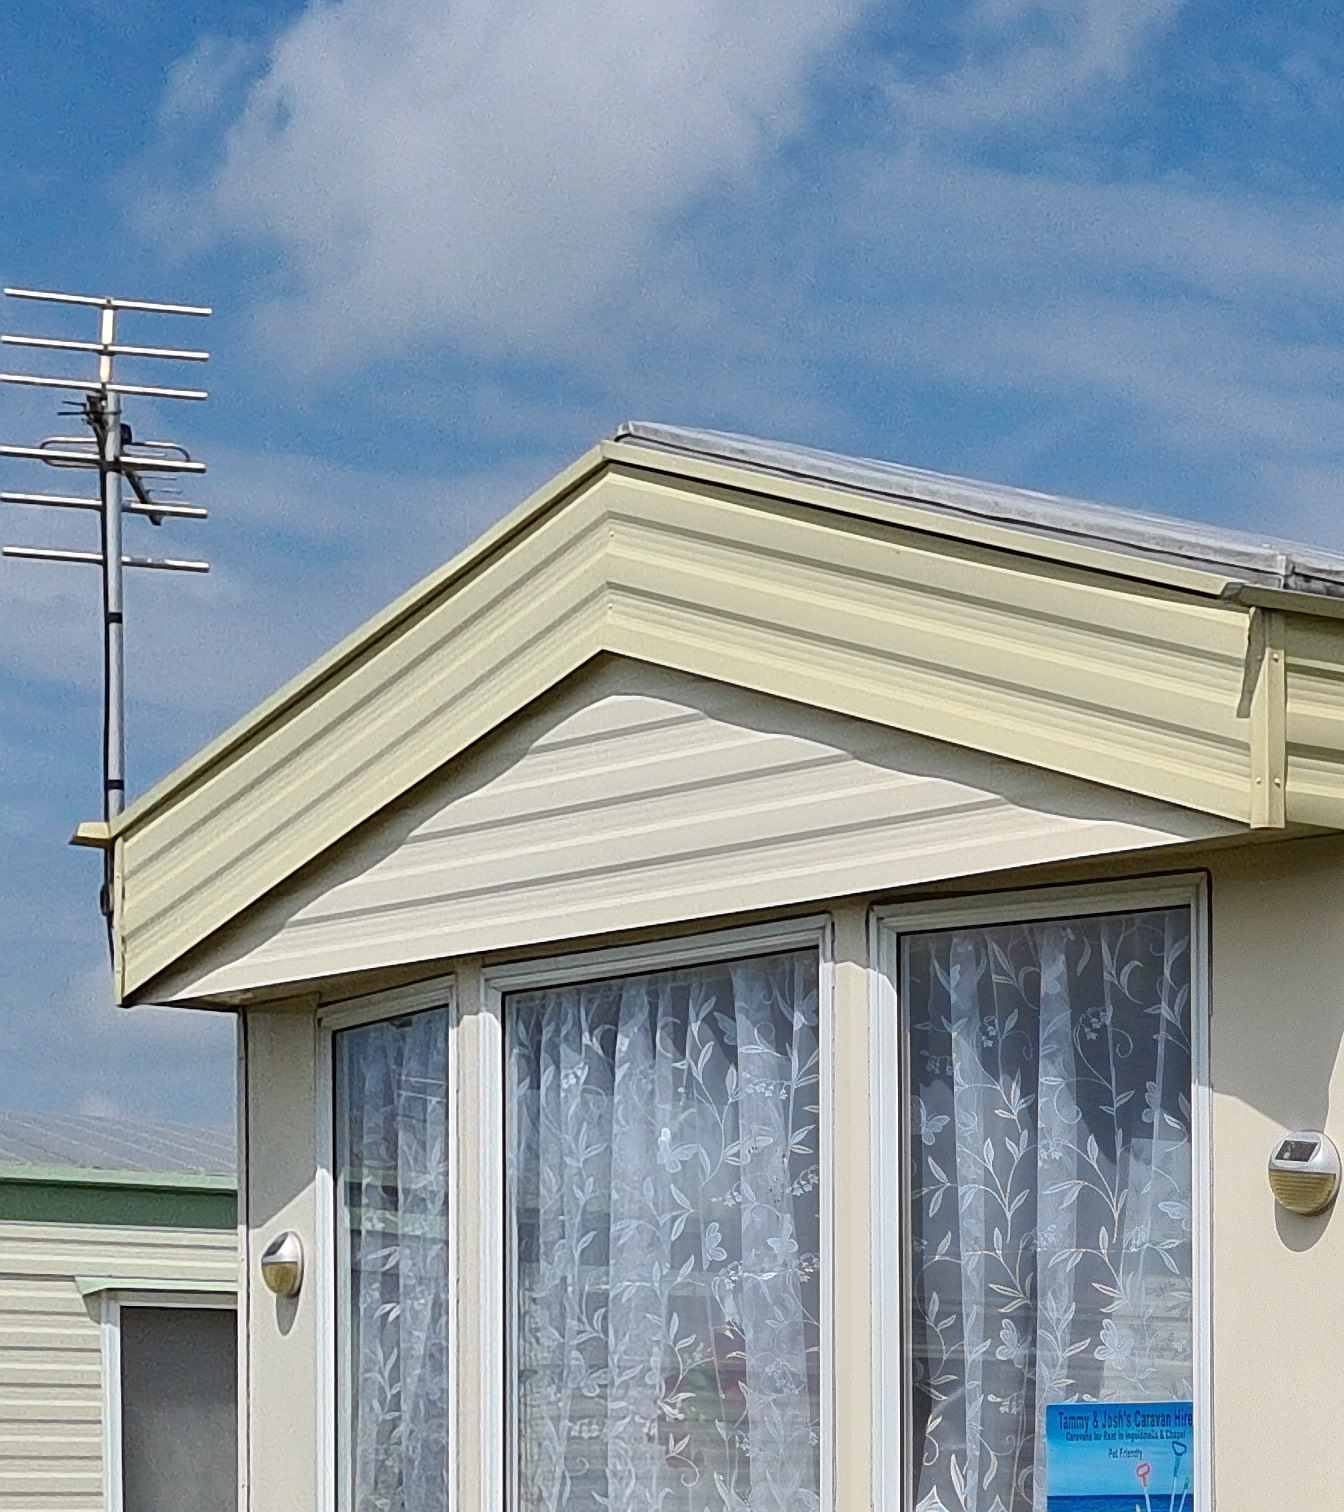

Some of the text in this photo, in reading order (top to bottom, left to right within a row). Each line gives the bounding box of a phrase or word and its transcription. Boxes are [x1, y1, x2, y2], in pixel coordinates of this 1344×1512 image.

[1058, 1408, 1193, 1433] Tammy & Josh's Caravan Hire
